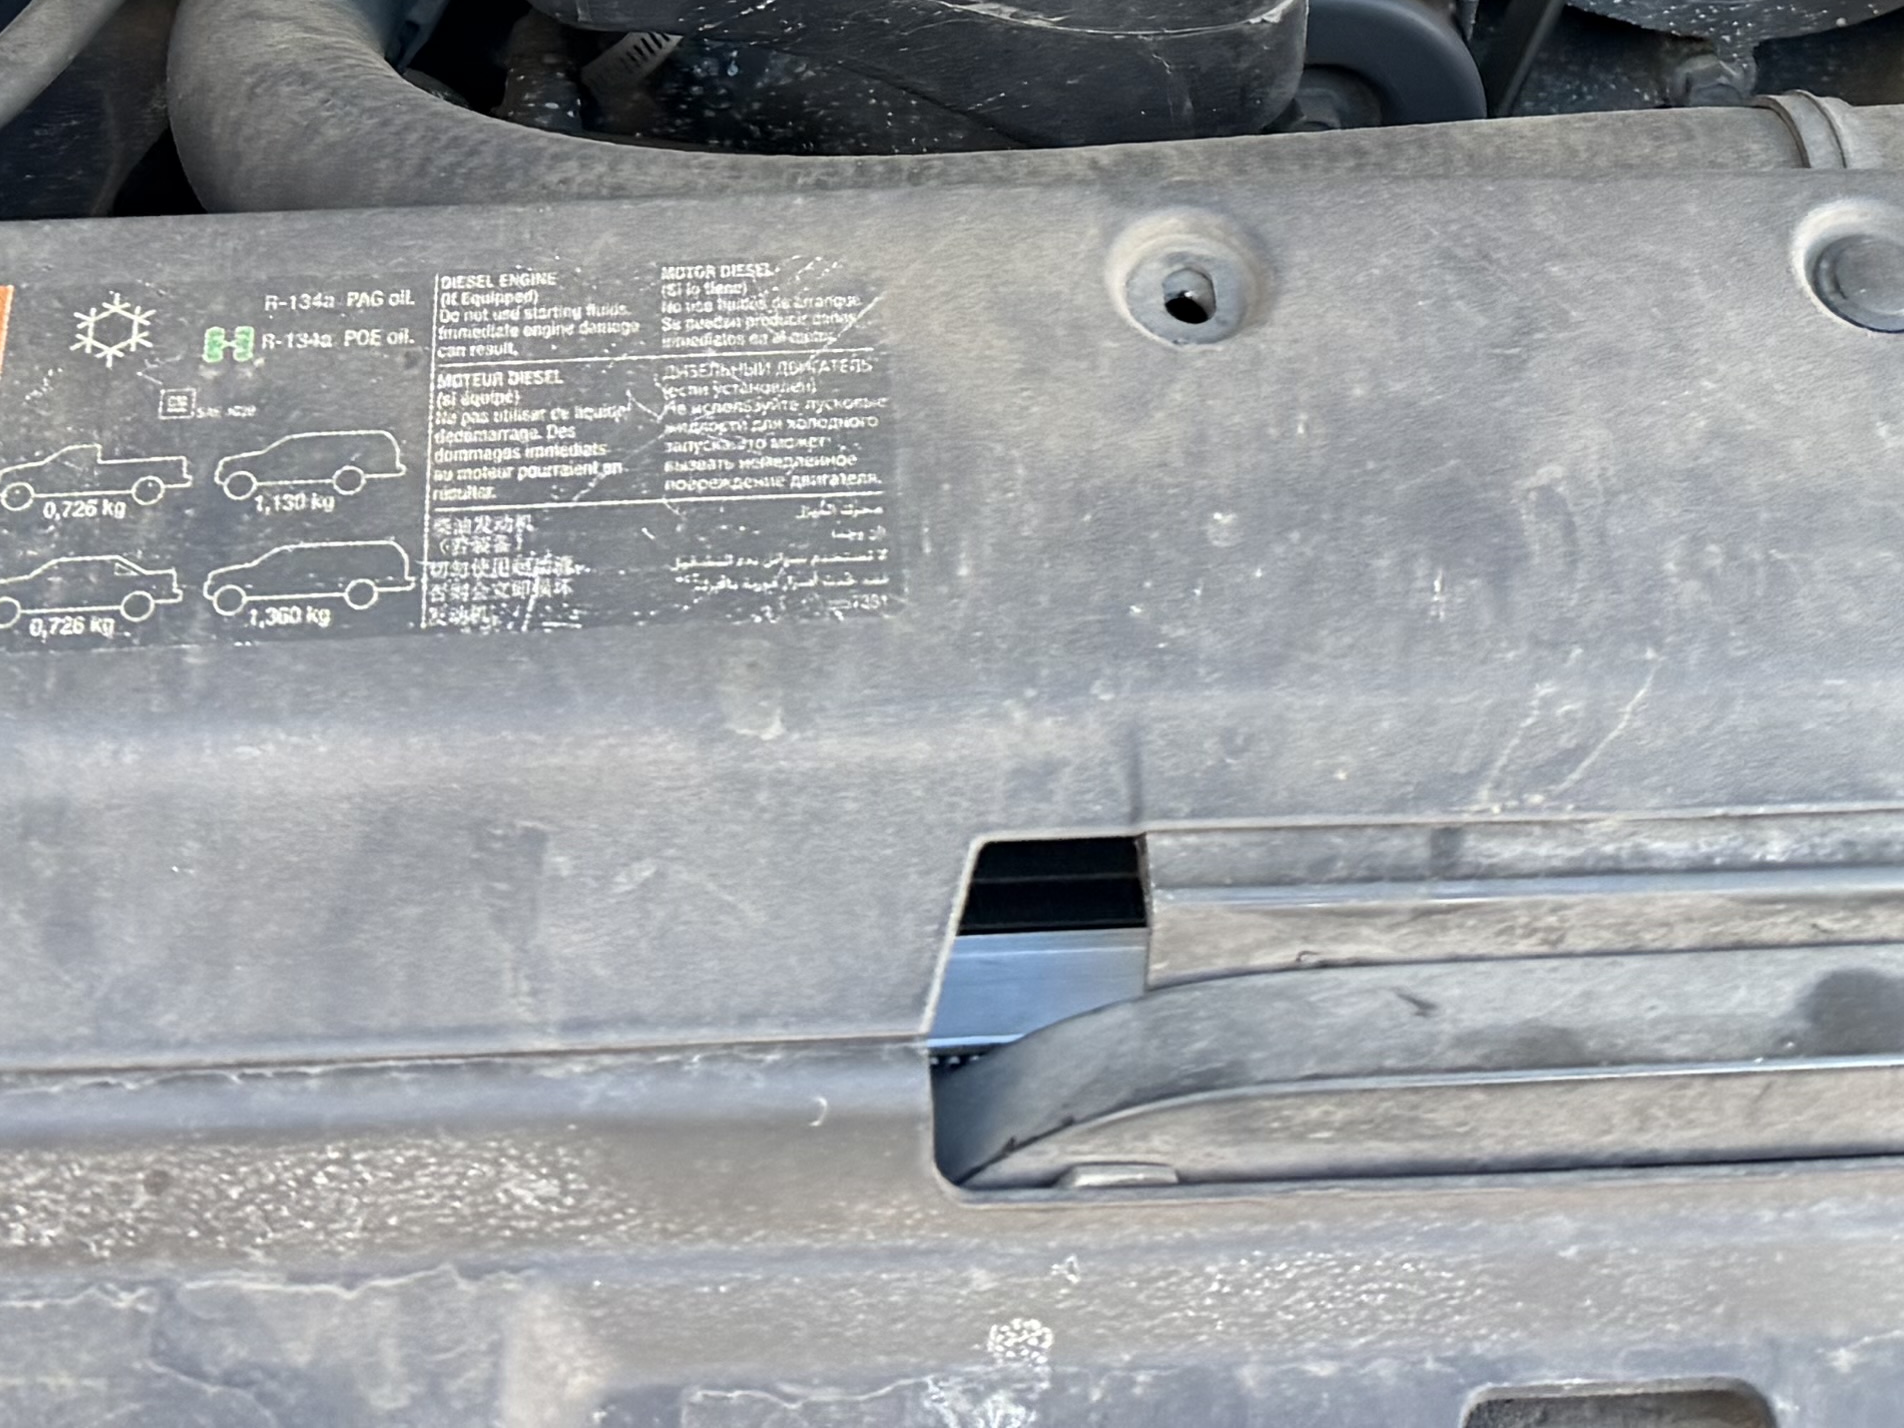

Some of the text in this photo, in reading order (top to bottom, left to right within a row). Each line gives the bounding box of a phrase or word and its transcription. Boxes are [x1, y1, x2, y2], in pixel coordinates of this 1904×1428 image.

[661, 262, 774, 280] MOTOR DIESEL
[441, 272, 557, 290] DIESEL ENGINE
[265, 293, 336, 311] R-134a
[347, 291, 384, 307] PAG
[662, 300, 682, 314] No
[439, 309, 460, 323] Do
[464, 308, 489, 322] not
[524, 305, 582, 321] starting
[261, 328, 415, 349] R-134a POE oil.
[438, 319, 641, 340] Immediate engine damage
[437, 344, 466, 358] can
[437, 369, 564, 389] MOTEUR DIESEL
[460, 411, 489, 427] pas
[546, 424, 576, 439] Des
[517, 461, 598, 480] pourraient
[43, 499, 127, 520] 0,726 kg
[309, 493, 335, 512] kg
[305, 607, 332, 626] kg
[29, 615, 115, 638] 0,726 kg
